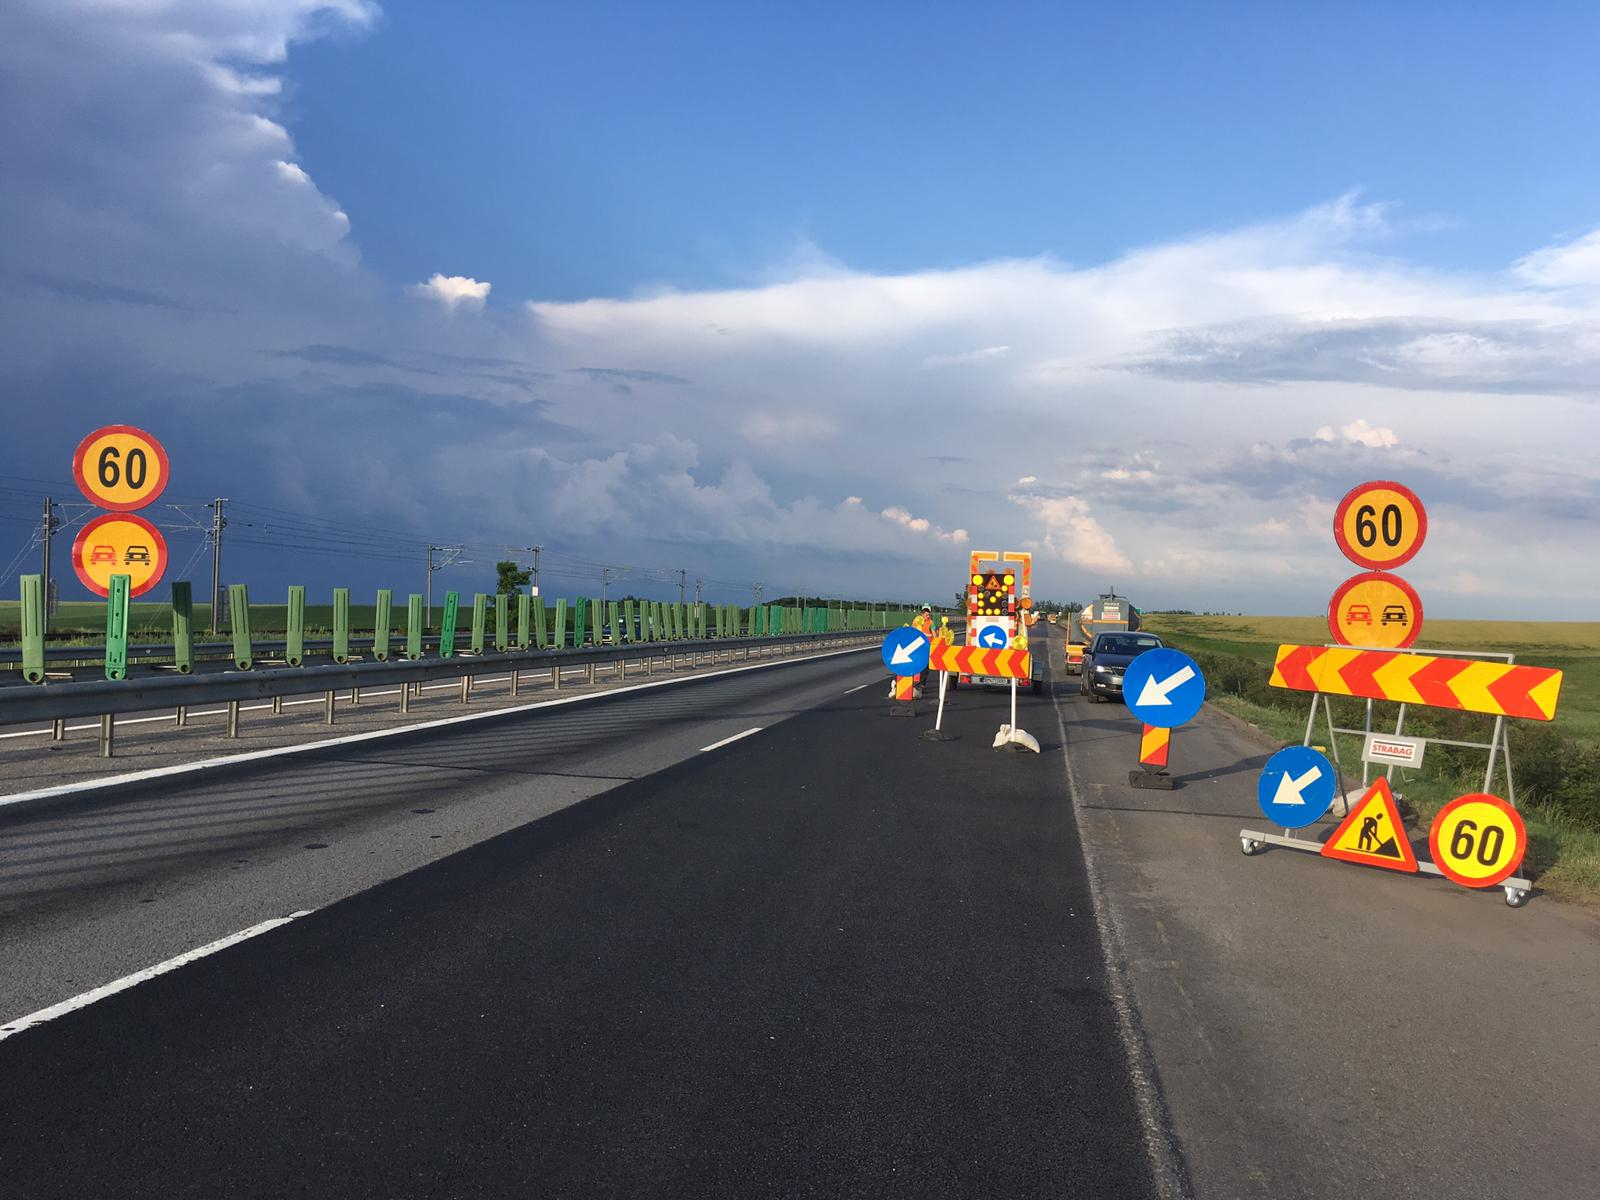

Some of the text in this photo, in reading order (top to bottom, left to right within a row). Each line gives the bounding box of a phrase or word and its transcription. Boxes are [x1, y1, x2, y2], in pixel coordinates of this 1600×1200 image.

[98, 446, 147, 489] 60
[1356, 504, 1402, 547] 60
[1372, 744, 1412, 756] STRABAG
[1450, 819, 1504, 866] 60
